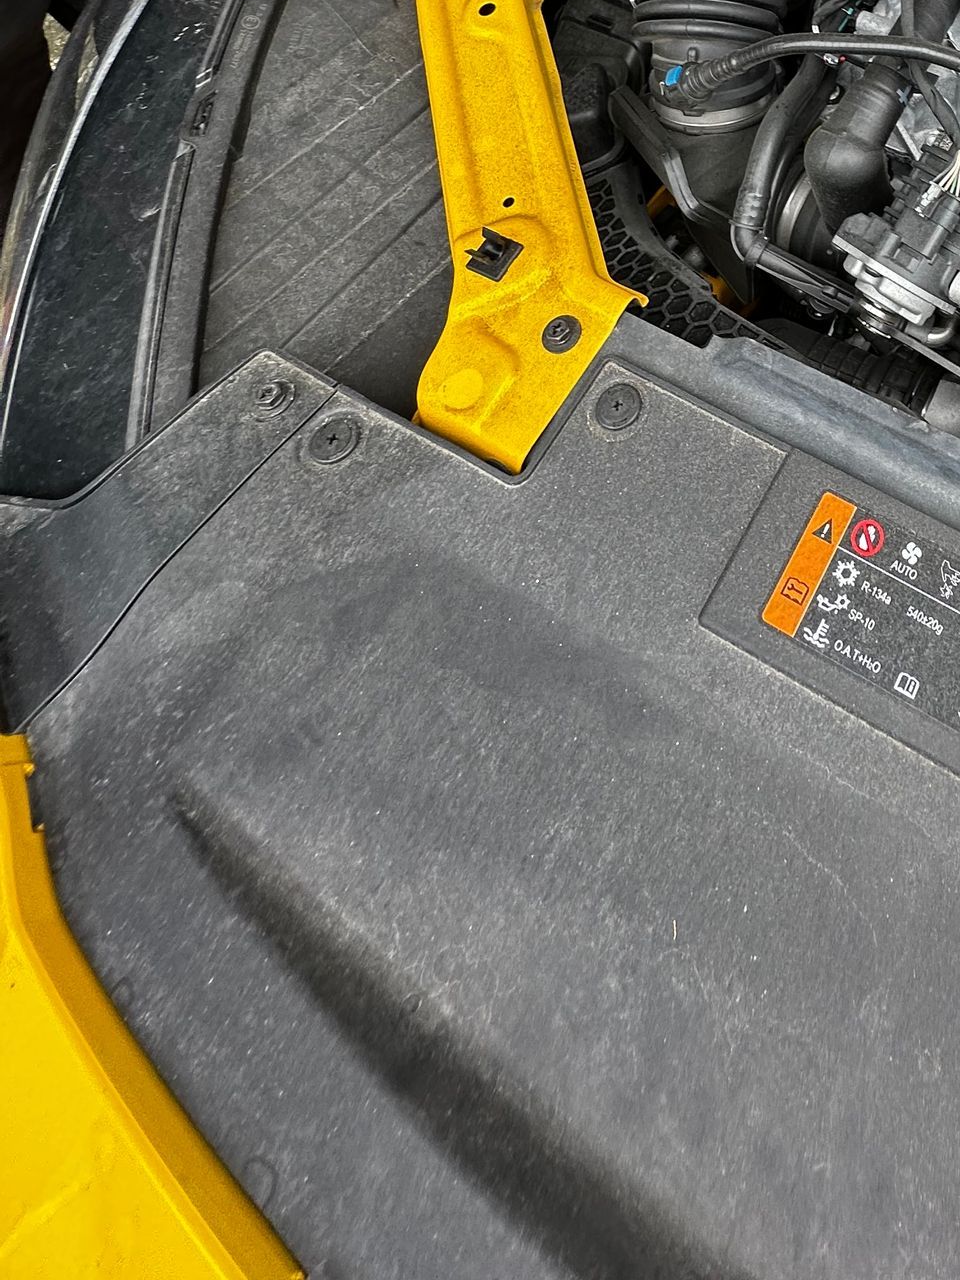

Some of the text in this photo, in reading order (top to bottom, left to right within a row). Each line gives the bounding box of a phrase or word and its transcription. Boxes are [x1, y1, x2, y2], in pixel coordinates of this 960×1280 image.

[889, 560, 918, 580] AUTO
[848, 608, 876, 631] SP-10
[860, 580, 944, 636] R-134a 540±20g
